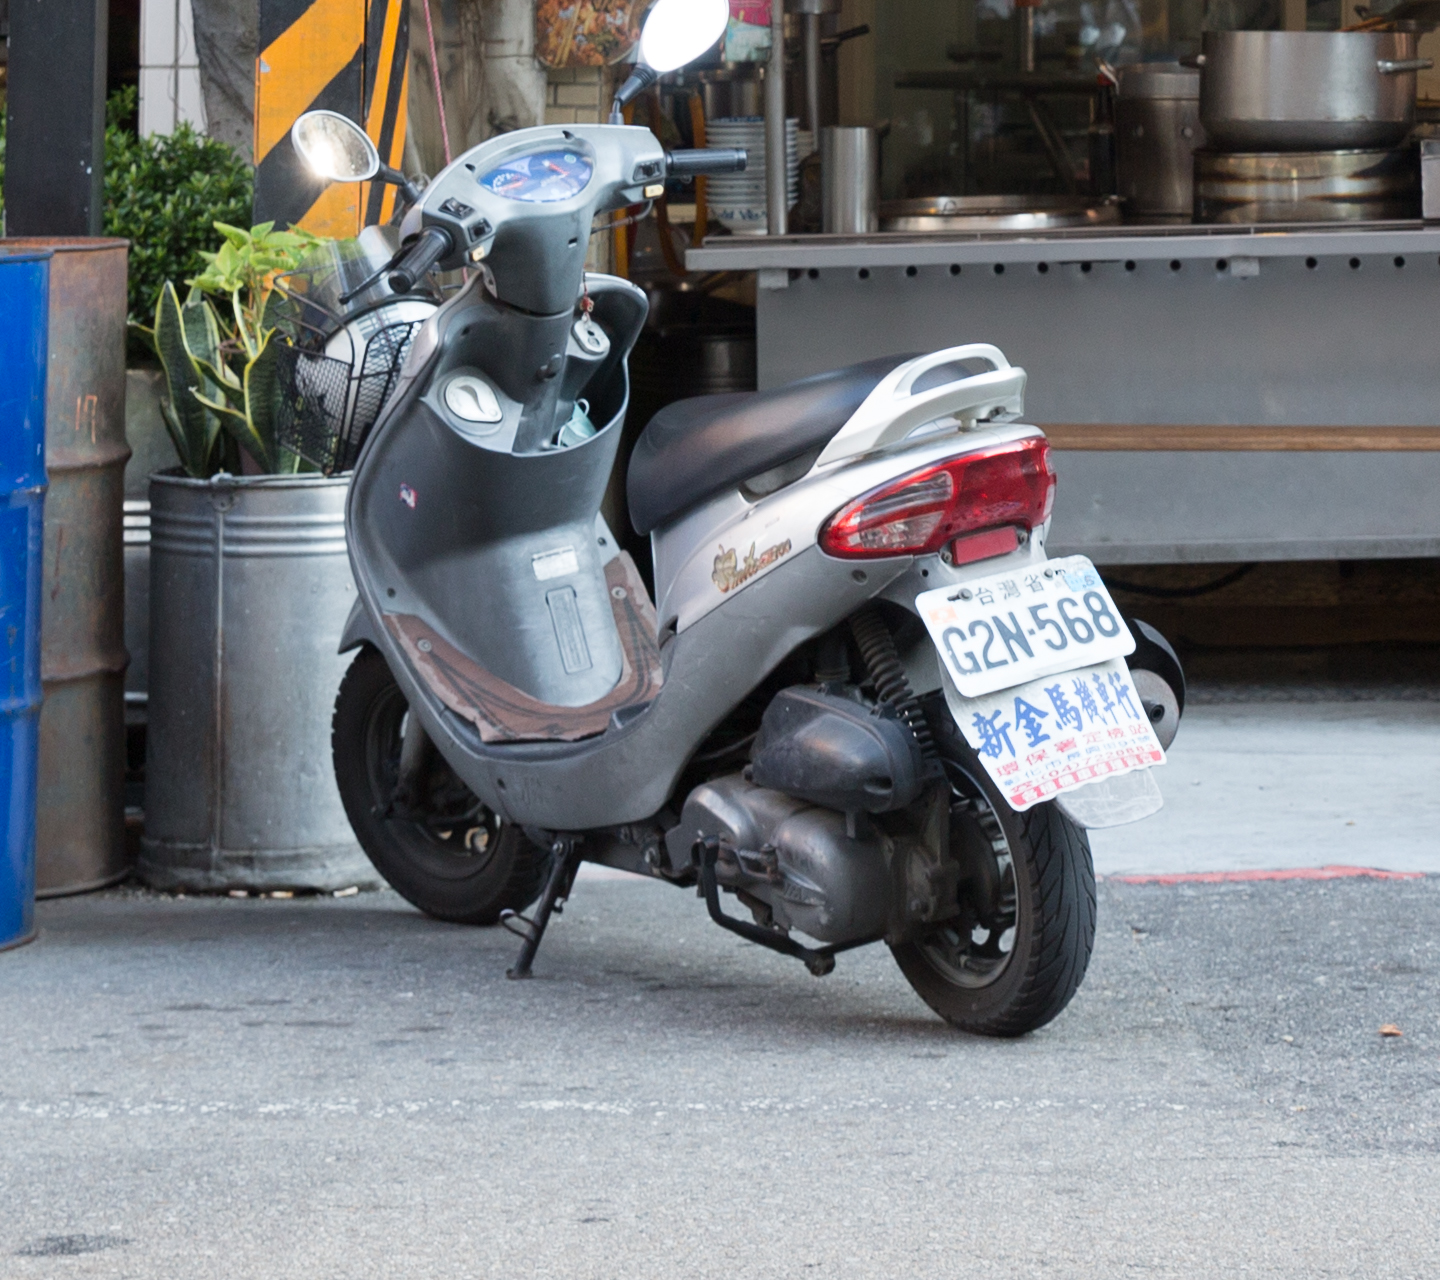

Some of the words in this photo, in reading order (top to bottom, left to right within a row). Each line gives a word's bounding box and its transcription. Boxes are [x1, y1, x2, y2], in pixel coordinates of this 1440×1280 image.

[974, 572, 1046, 606] 台灣省
[971, 671, 1141, 760] 新金馬機車行
